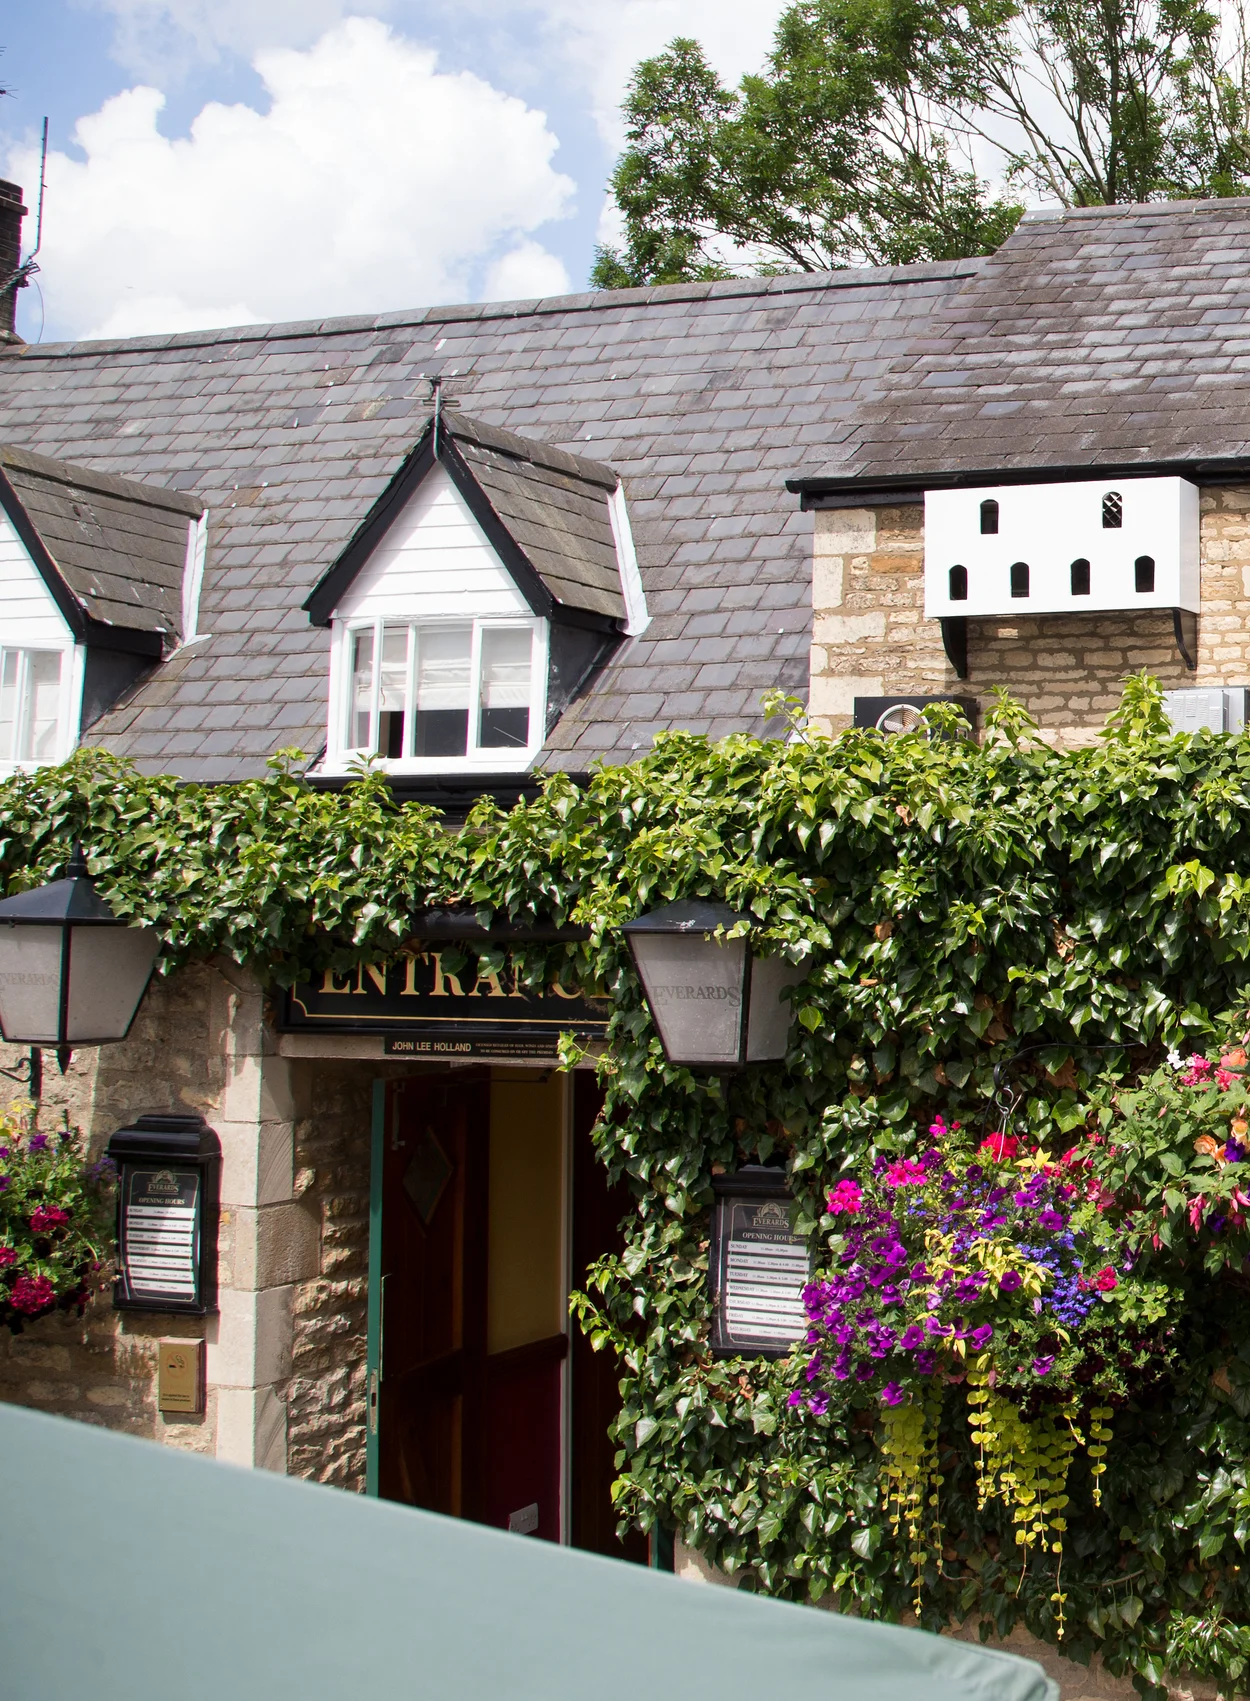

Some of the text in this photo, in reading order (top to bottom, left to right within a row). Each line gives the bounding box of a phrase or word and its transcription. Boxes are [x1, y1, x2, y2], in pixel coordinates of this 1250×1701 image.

[651, 986, 742, 1007] EVERARDS
[392, 1041, 472, 1052] JOHN LEE HOLLAND
[148, 1184, 180, 1193] EVERARDS
[753, 1217, 790, 1229] EVERARDS
[742, 1232, 798, 1242] OPENING HOURS
